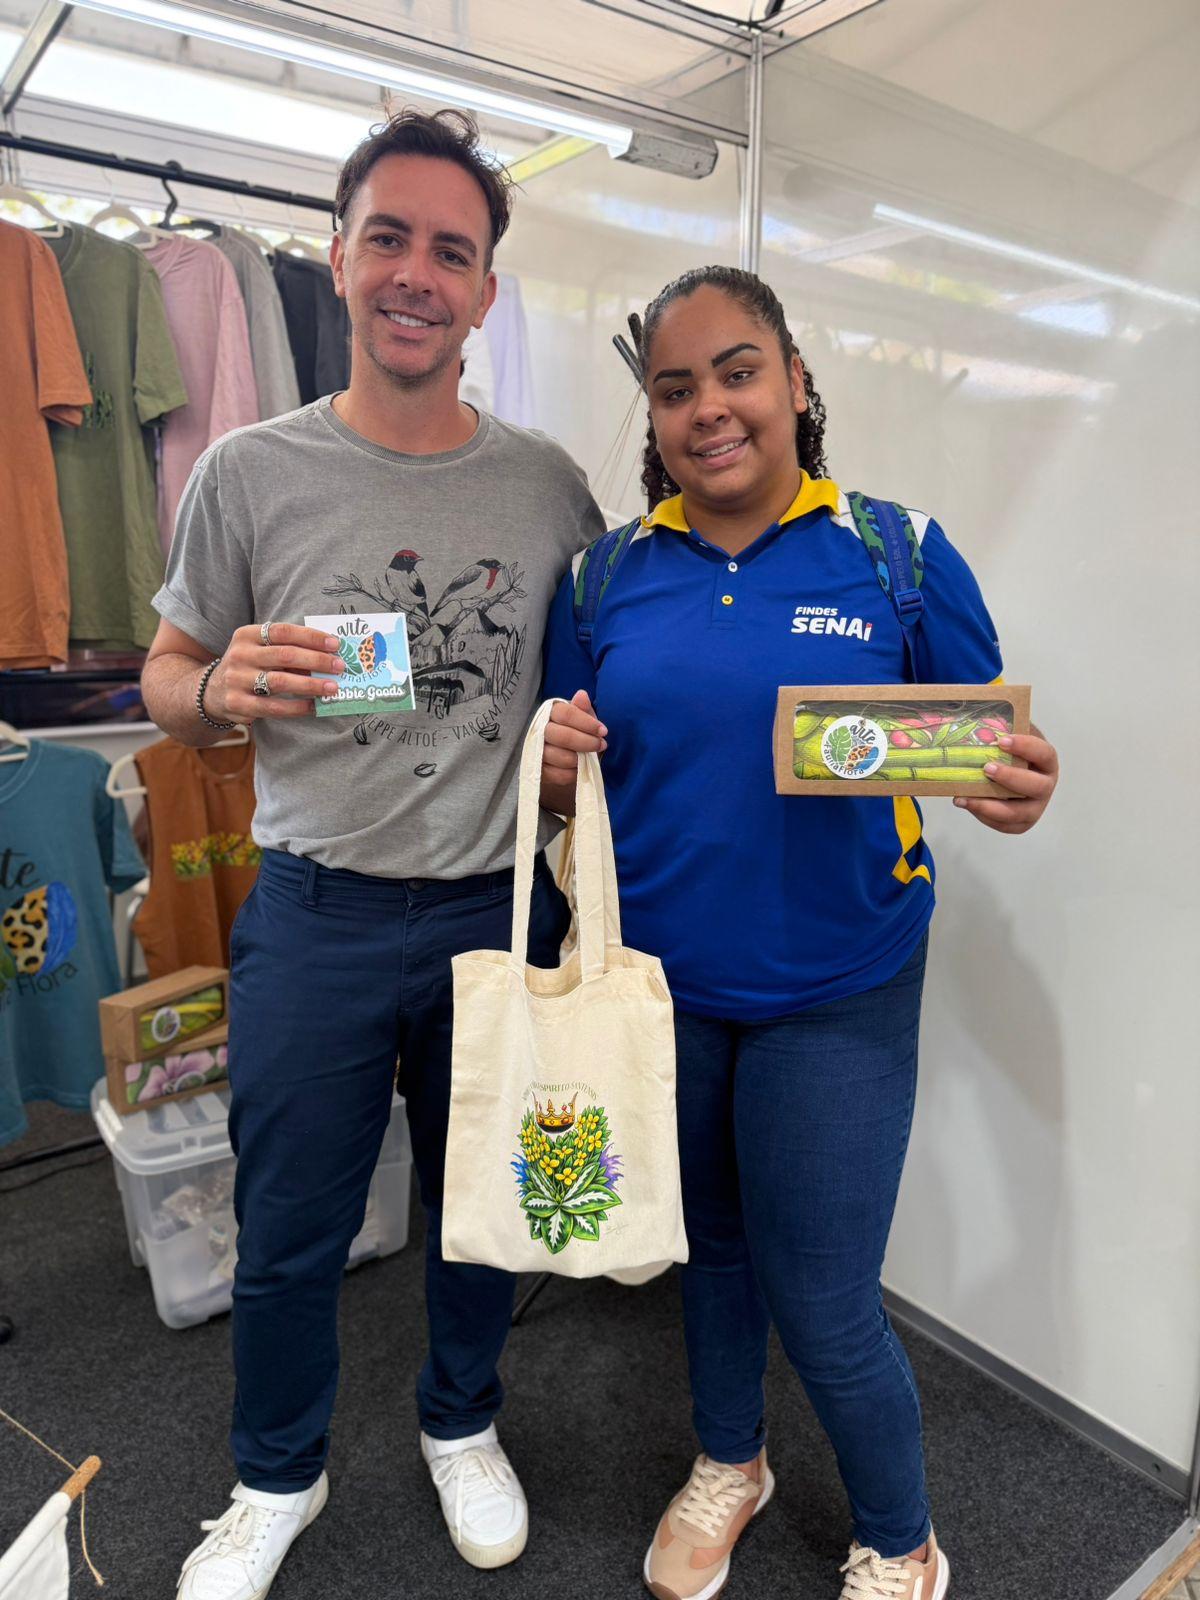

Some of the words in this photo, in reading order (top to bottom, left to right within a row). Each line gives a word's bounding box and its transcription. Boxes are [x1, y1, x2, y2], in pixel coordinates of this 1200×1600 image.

[795, 606, 839, 617] FINDES
[337, 617, 371, 637] arte
[338, 661, 388, 683] unaFlora
[367, 685, 405, 702] Goods
[452, 703, 503, 741] VARGEM
[849, 724, 877, 745] arte
[0, 847, 41, 890] te
